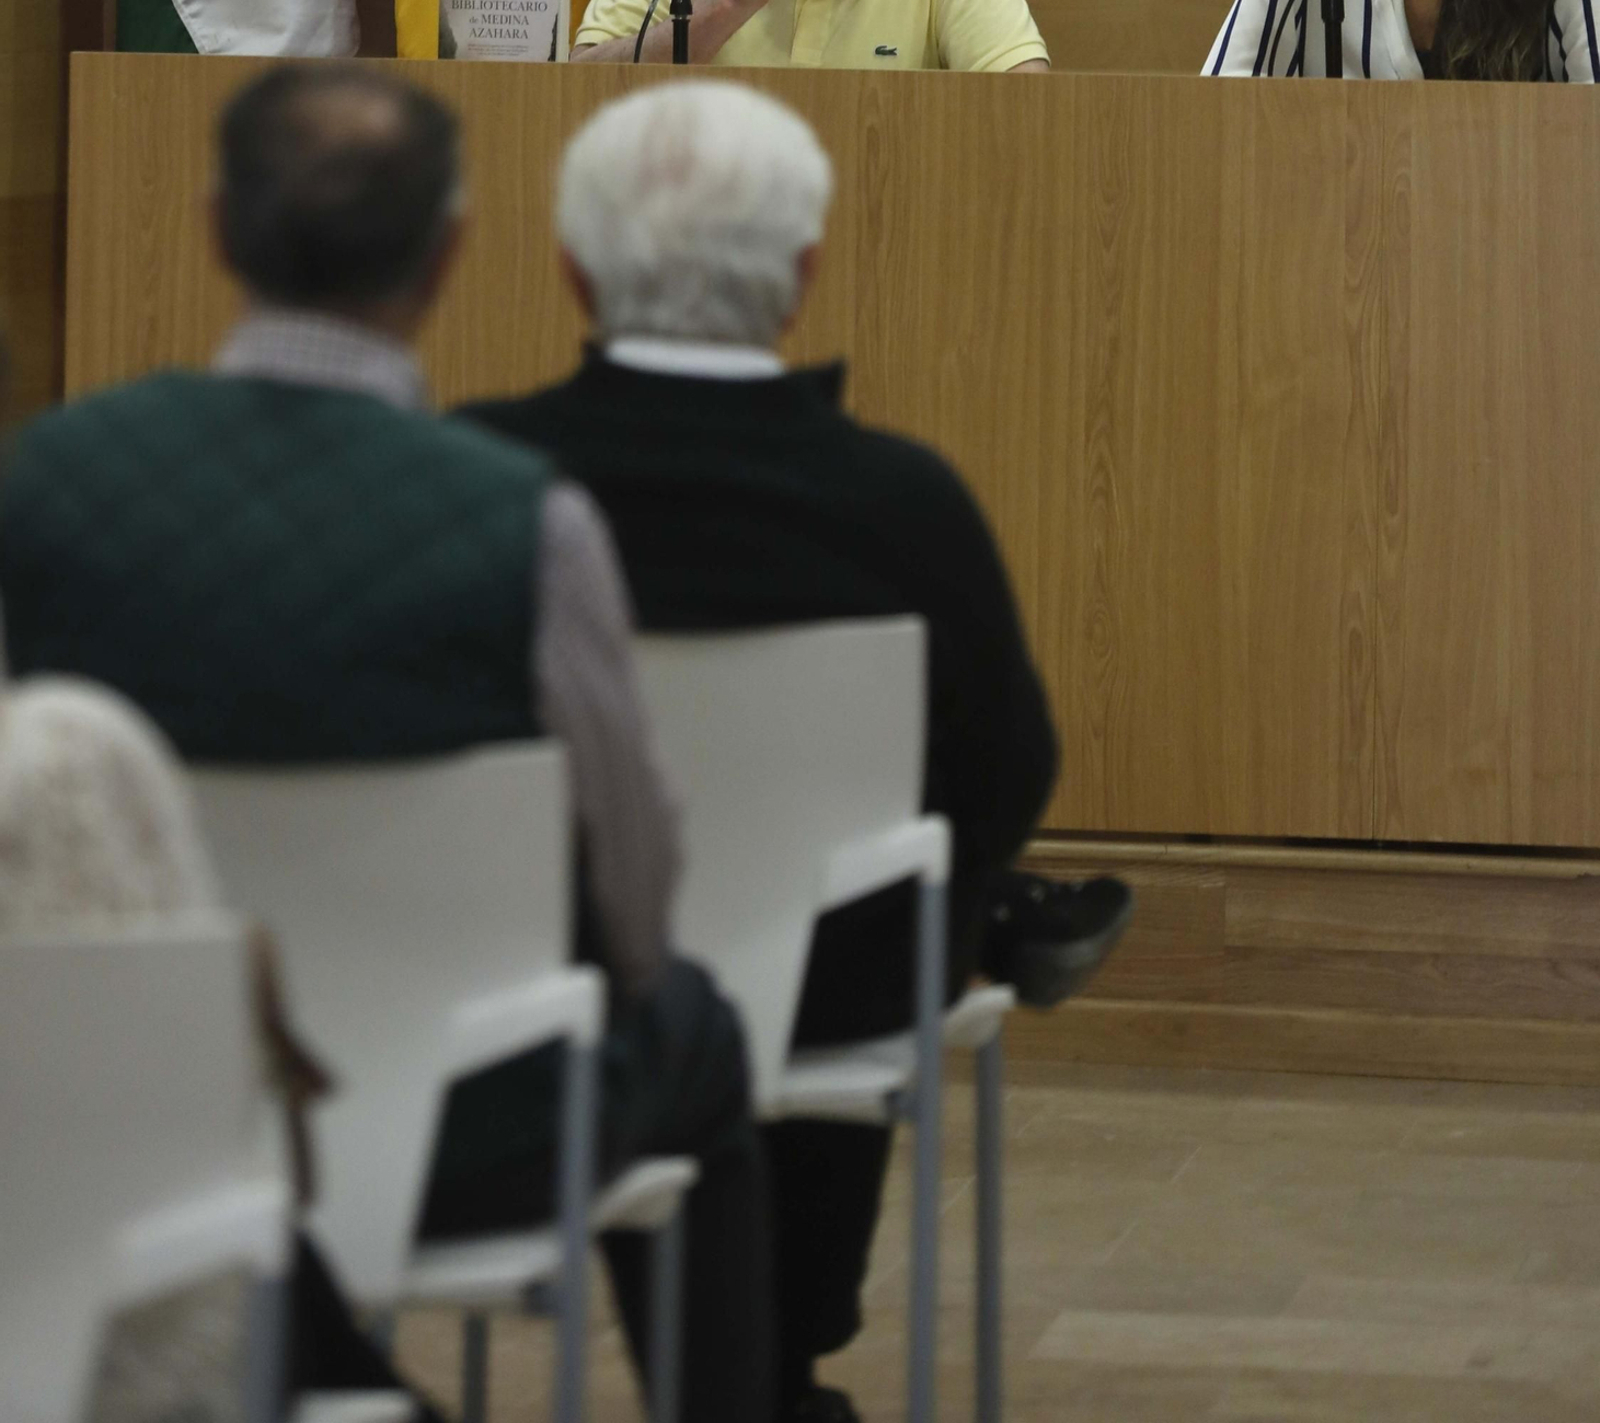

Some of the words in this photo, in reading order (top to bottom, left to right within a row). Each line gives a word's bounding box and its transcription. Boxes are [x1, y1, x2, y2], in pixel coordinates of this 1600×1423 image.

[451, 0, 548, 12] BIBLIOTECARIO
[481, 14, 530, 26] MEDINA
[469, 28, 529, 39] AZAHARA
